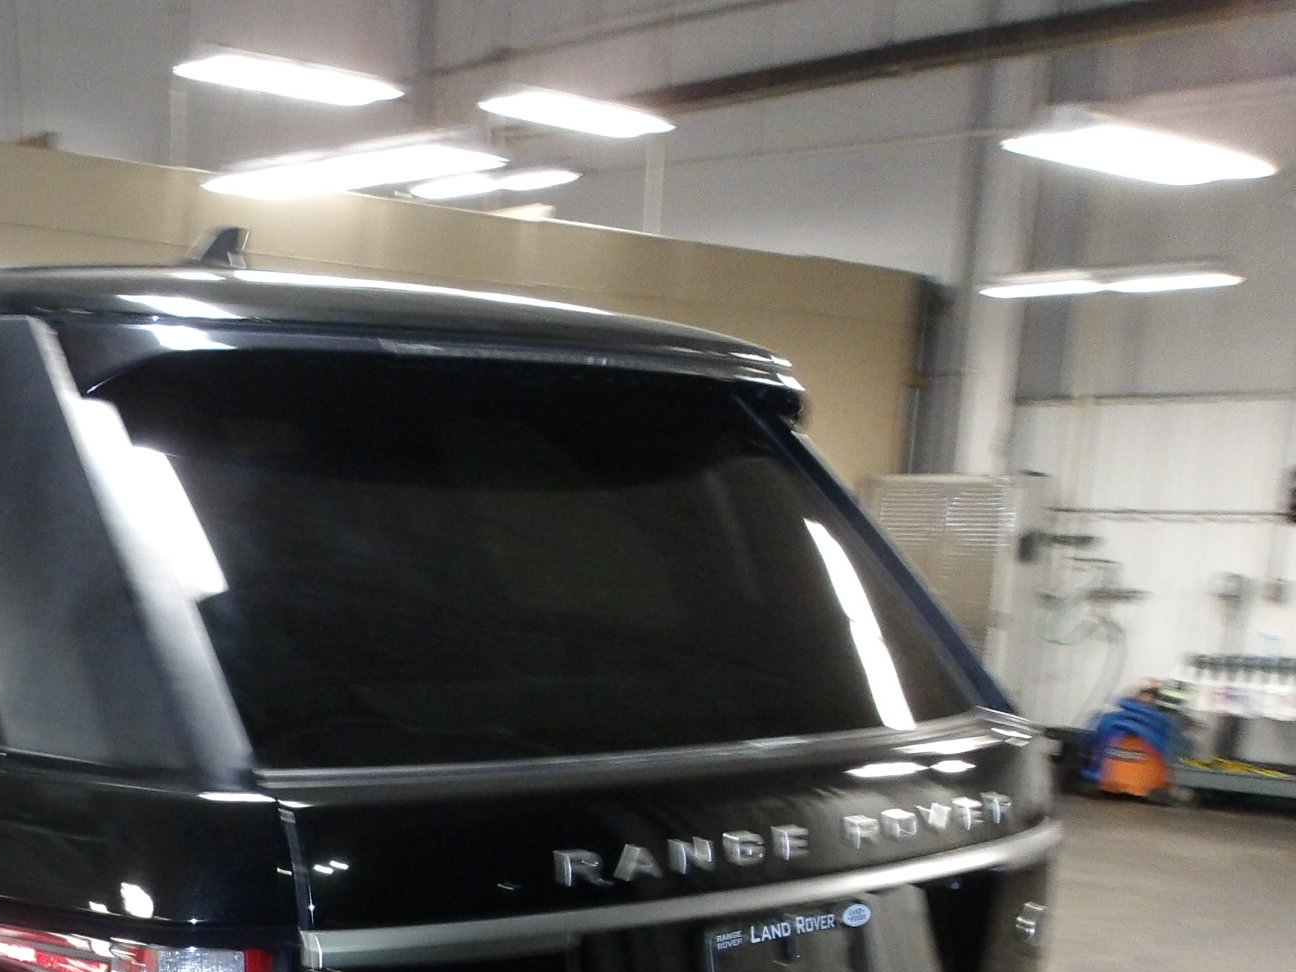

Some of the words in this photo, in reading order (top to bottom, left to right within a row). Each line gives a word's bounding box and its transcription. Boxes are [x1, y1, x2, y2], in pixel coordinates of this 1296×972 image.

[552, 823, 809, 887] RANGE
[716, 930, 743, 943] RANGE
[750, 922, 791, 944] LAND
[795, 914, 836, 935] ROVER
[717, 938, 744, 951] ROVER
